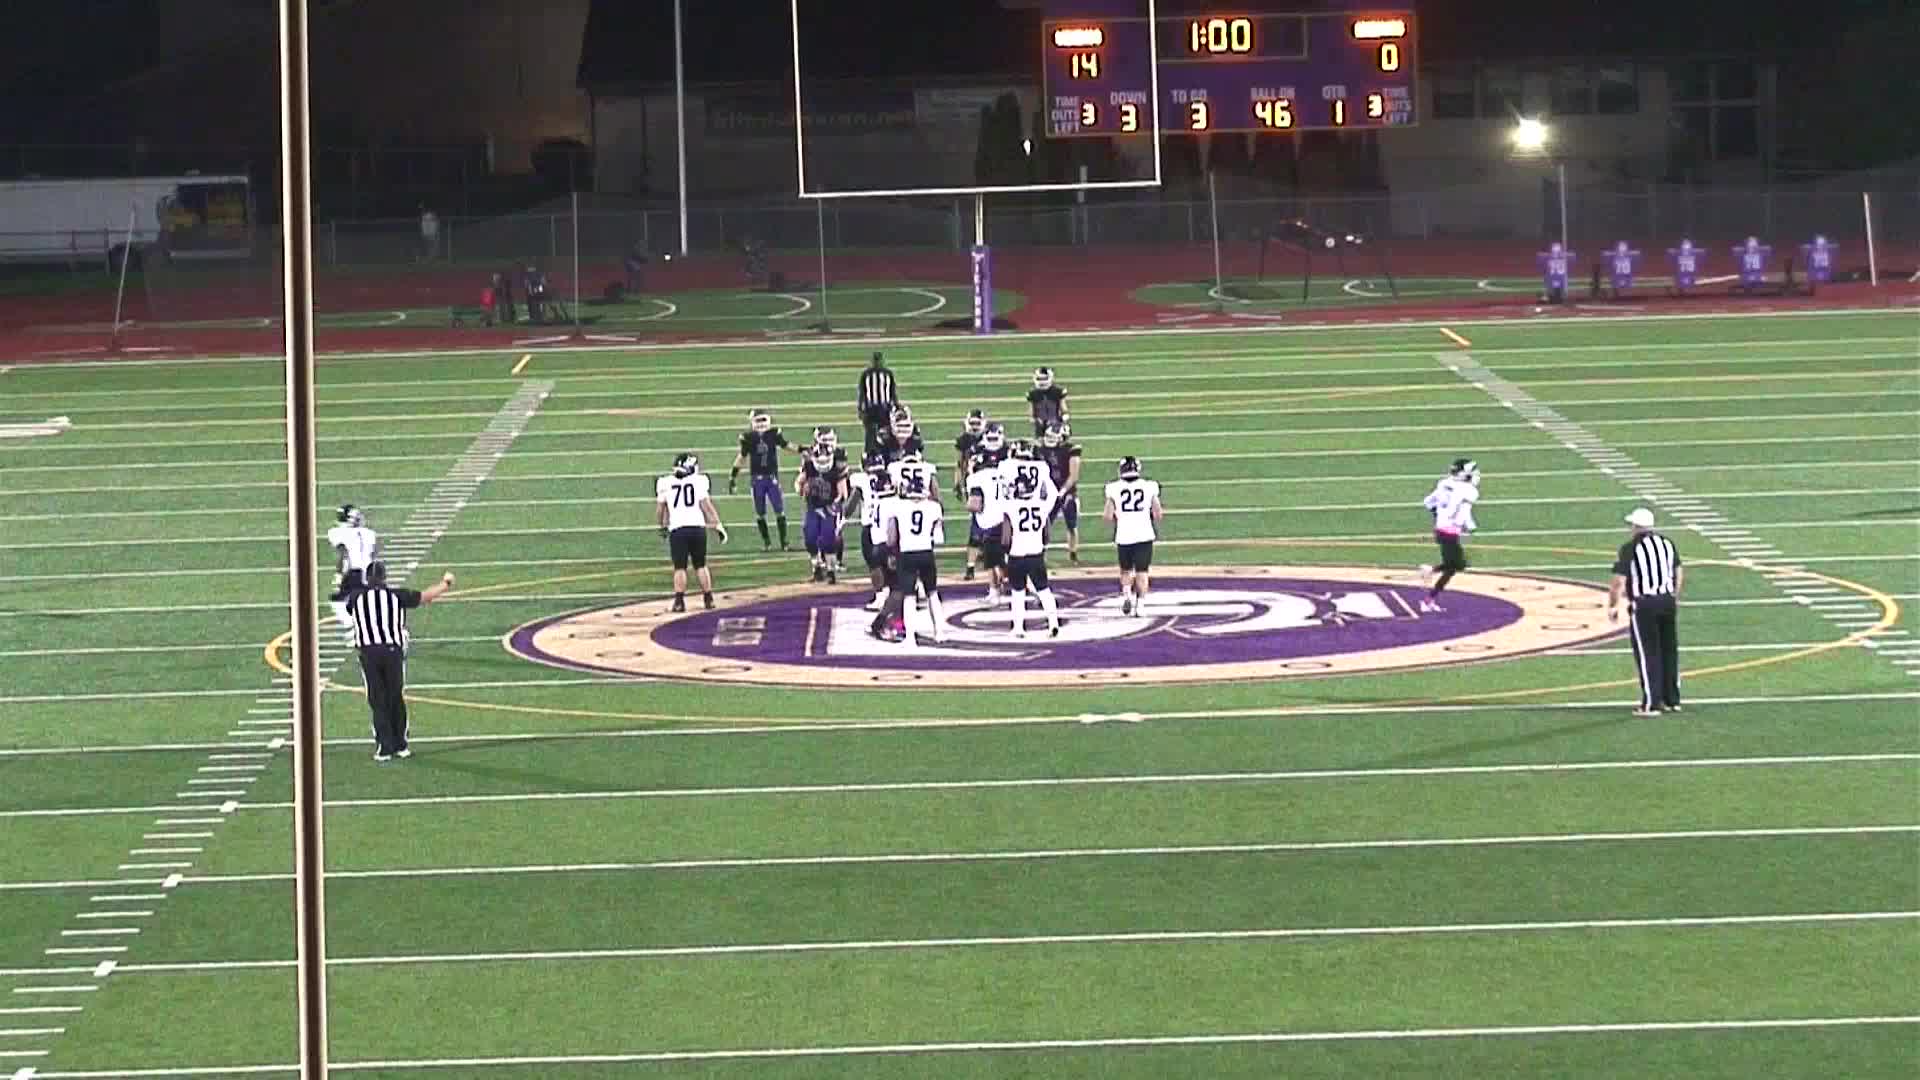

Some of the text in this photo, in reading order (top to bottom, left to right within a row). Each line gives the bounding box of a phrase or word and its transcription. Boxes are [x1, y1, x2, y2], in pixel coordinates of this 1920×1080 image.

[1191, 18, 1251, 52] 1:00
[1072, 52, 1098, 79] 14
[1381, 43, 1399, 71] 0
[1110, 91, 1147, 105] DOWN
[1367, 94, 1382, 118] 3
[1082, 102, 1096, 125] 3
[1121, 103, 1137, 132] 3
[1191, 102, 1207, 129] 3
[1255, 99, 1291, 128] 46
[1335, 99, 1343, 124] 1
[671, 482, 695, 508] 70
[1120, 488, 1144, 512] 22
[910, 510, 924, 535] 9
[1018, 506, 1042, 532] 25
